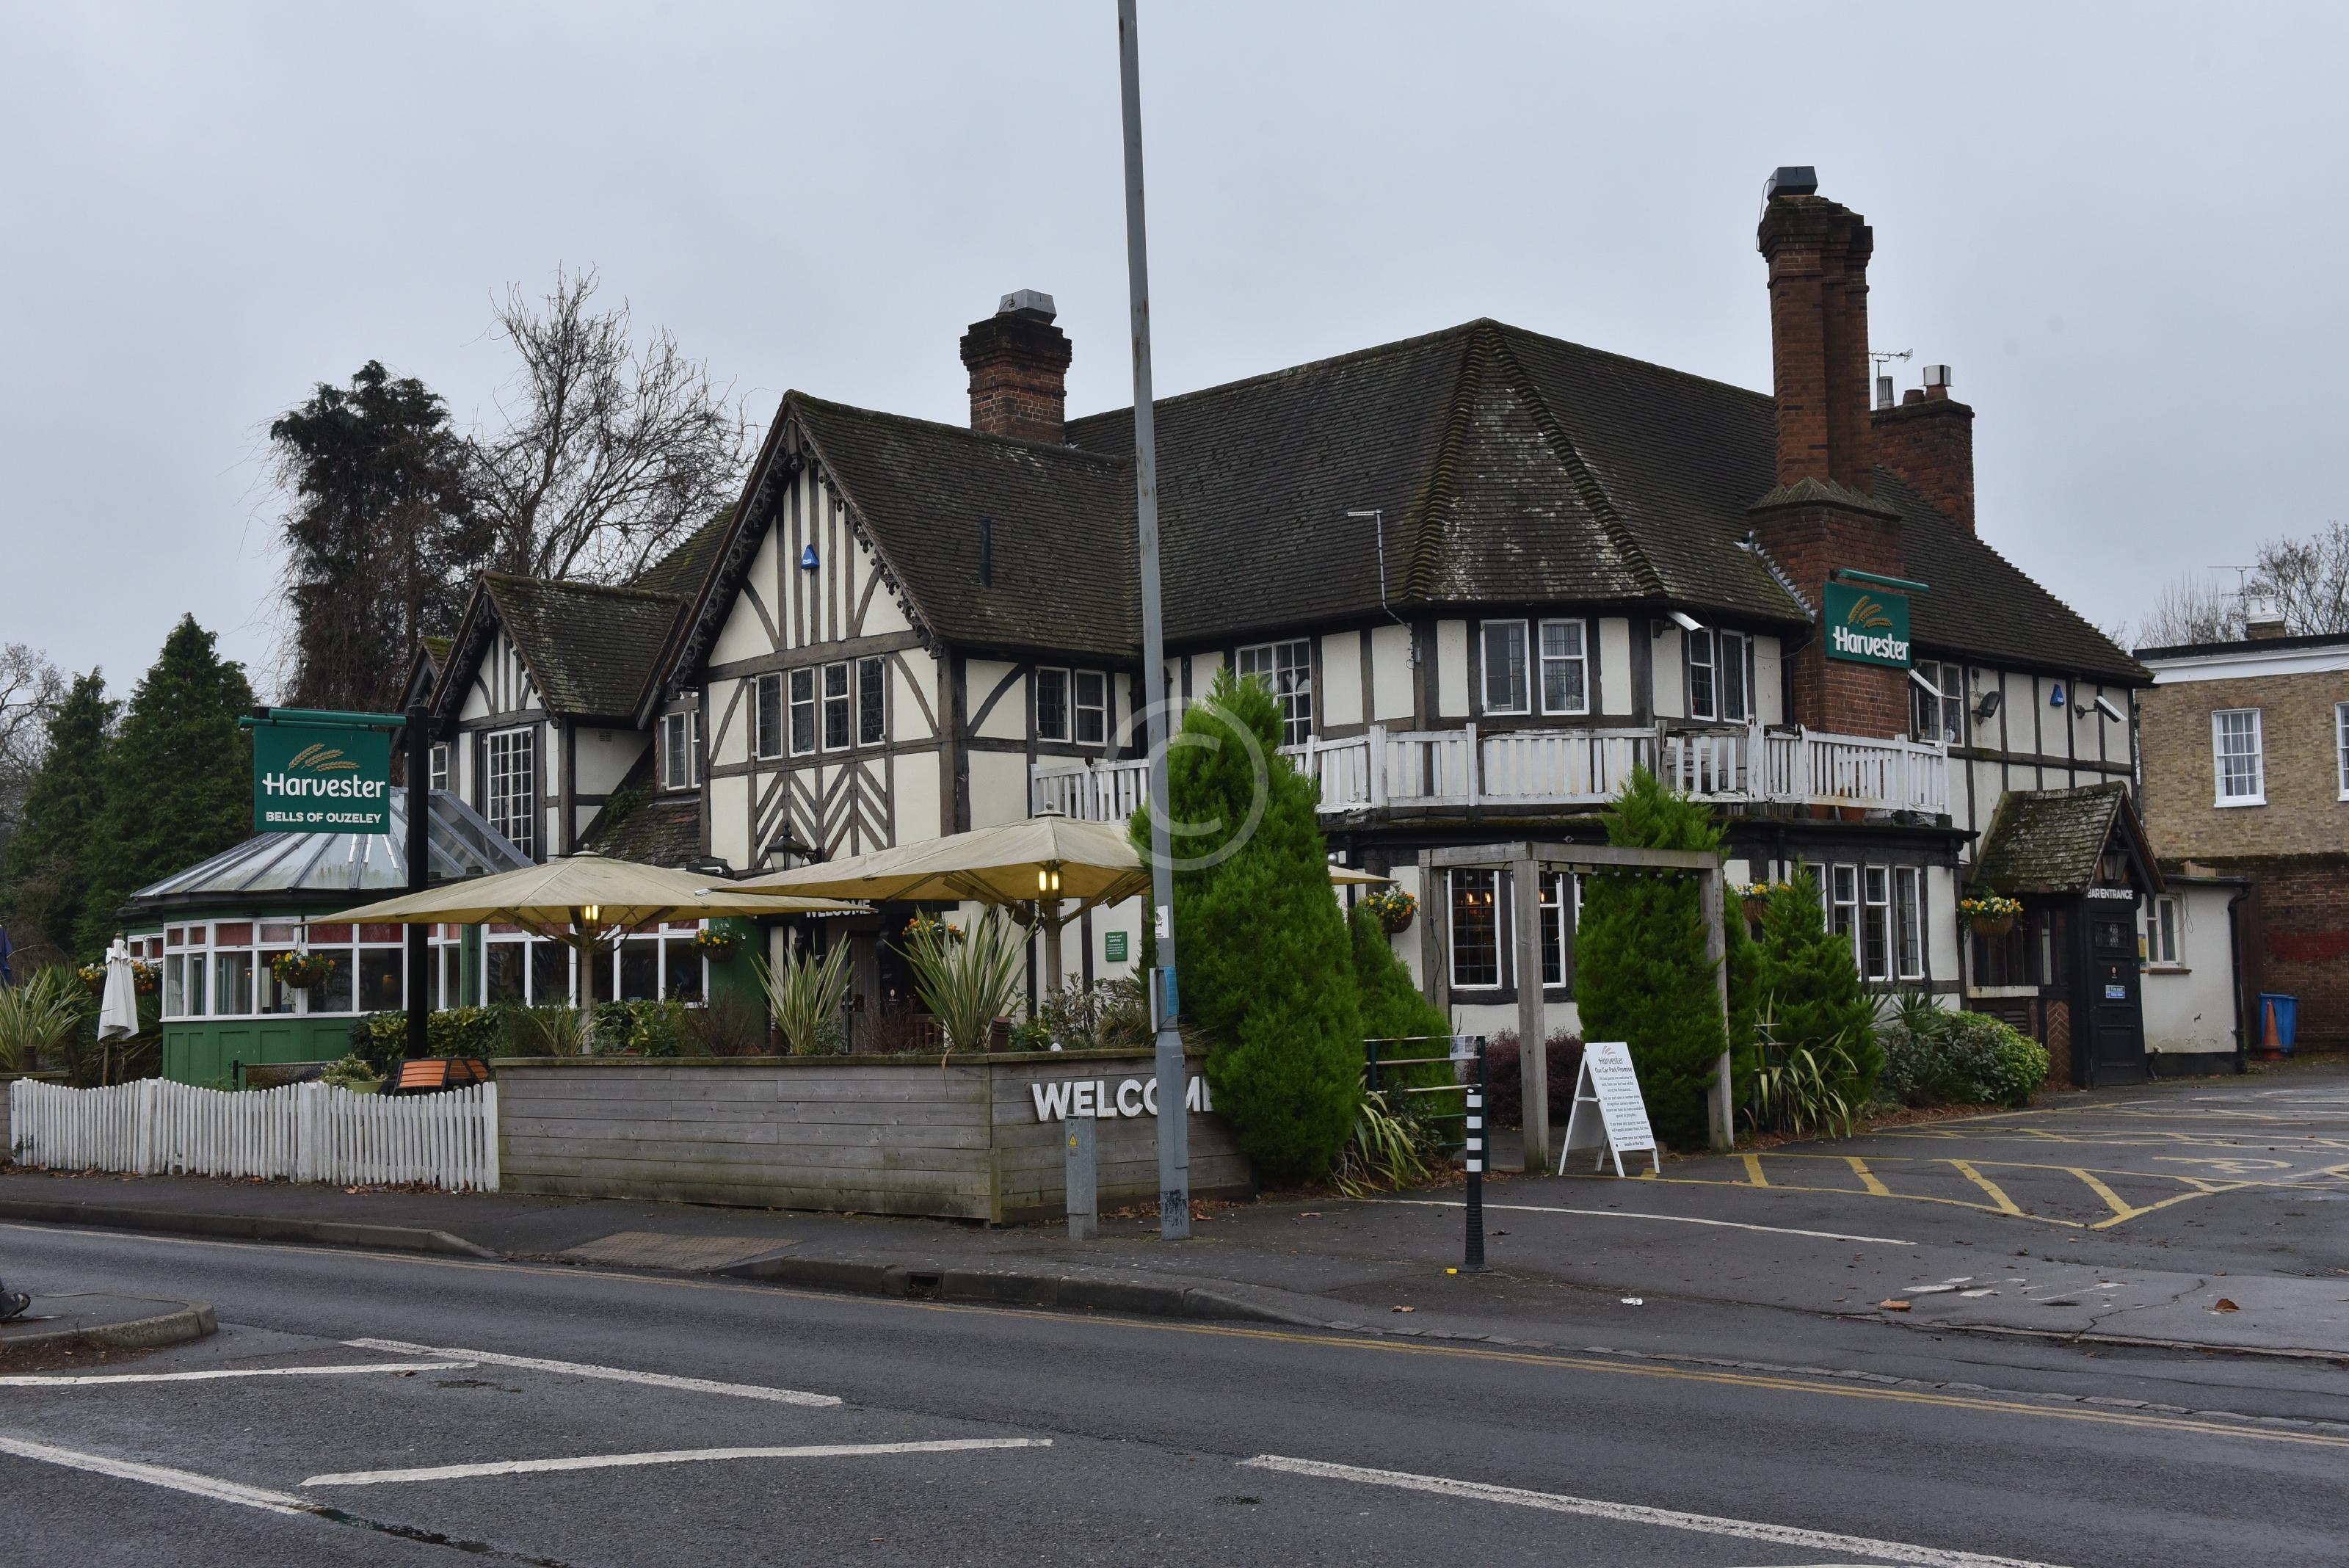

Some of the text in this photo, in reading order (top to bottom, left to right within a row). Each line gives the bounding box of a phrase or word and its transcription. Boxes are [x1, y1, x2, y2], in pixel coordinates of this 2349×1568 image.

[1832, 626, 1909, 660] Harvester
[262, 772, 385, 798] Harvester
[266, 811, 382, 824] BELLS OF OUZELEY
[2087, 888, 2133, 900] BAR ENTRANCE
[1598, 1056, 1623, 1064] Harvester
